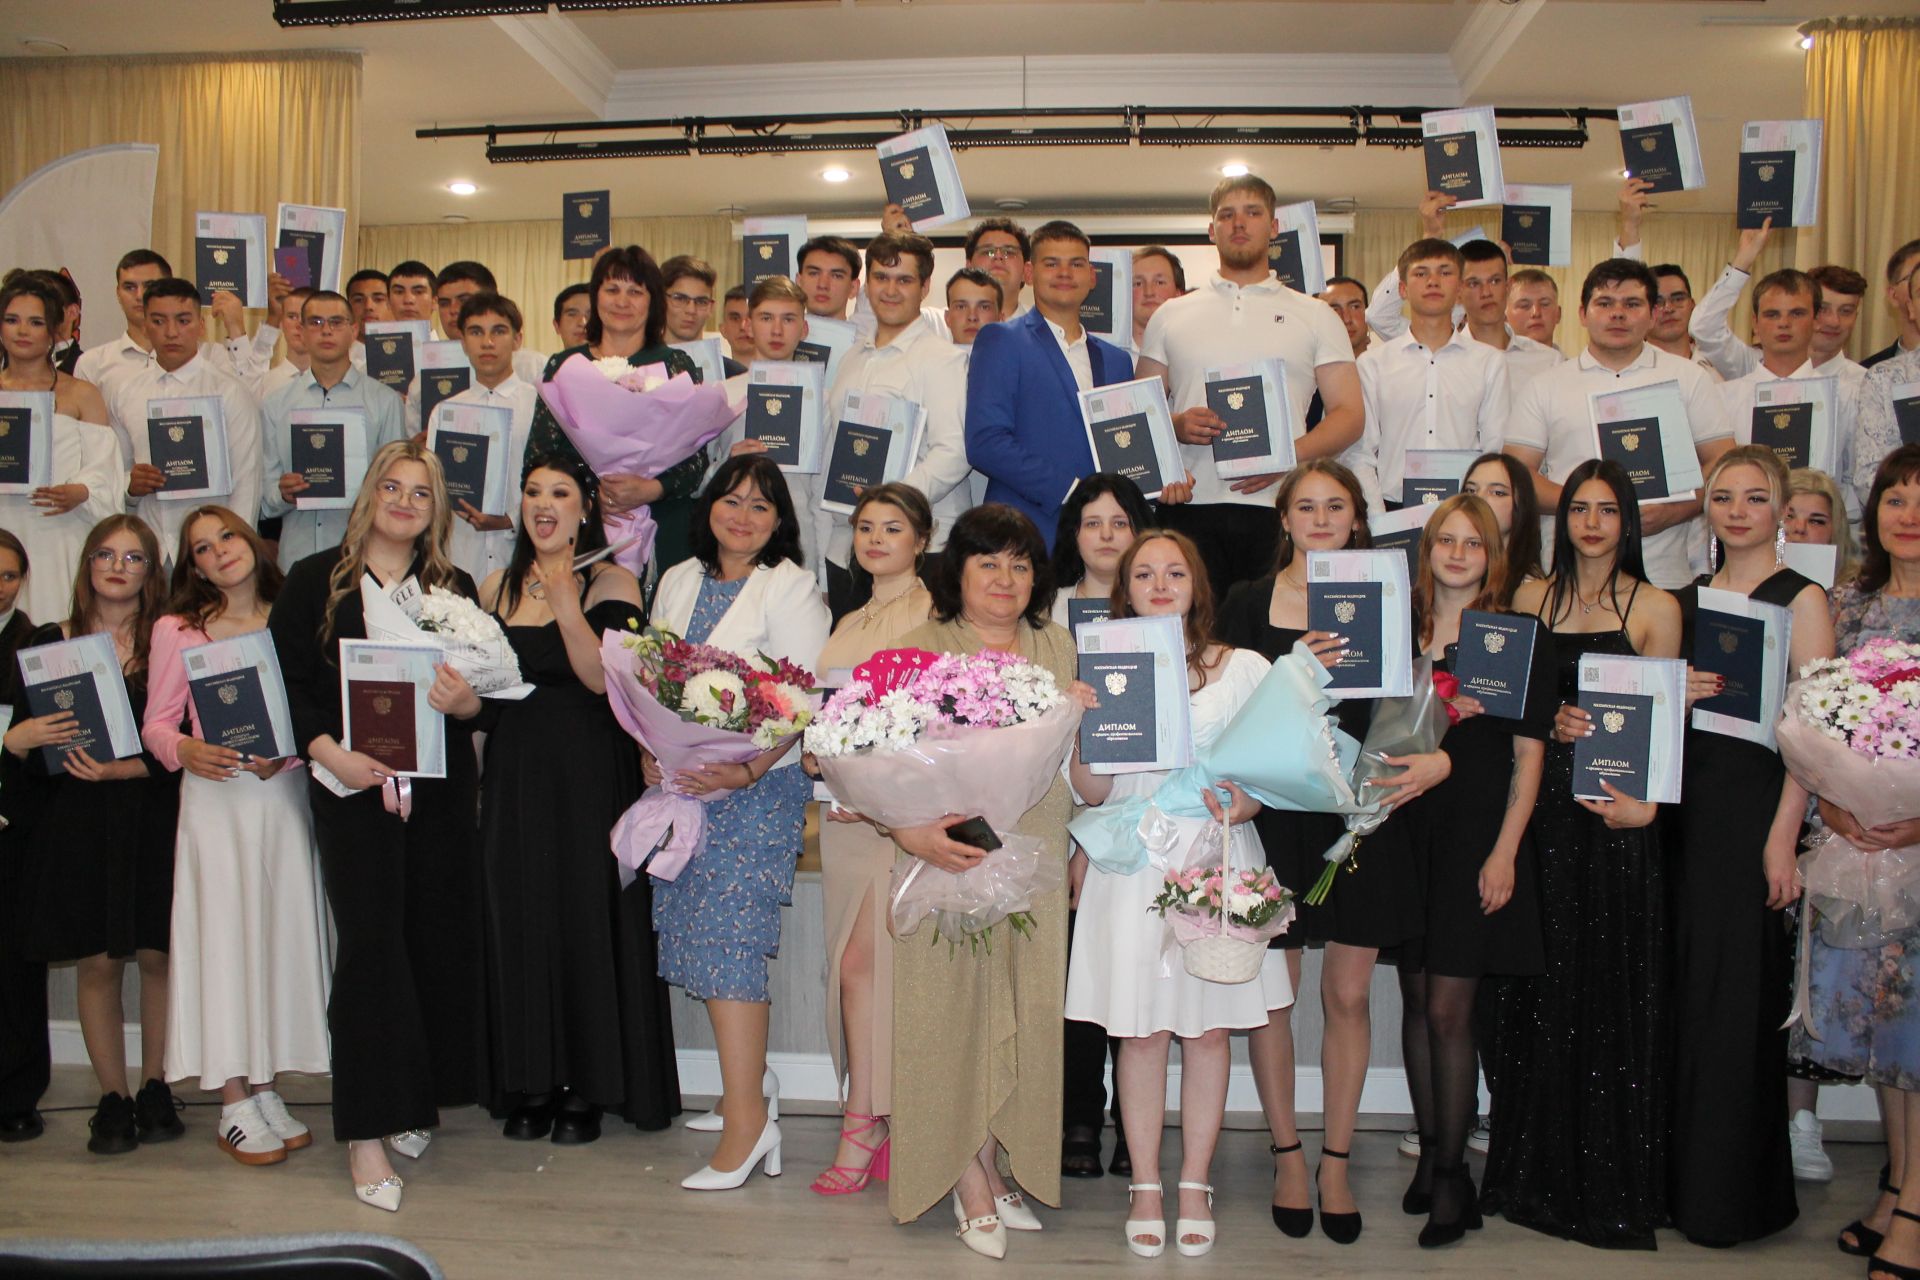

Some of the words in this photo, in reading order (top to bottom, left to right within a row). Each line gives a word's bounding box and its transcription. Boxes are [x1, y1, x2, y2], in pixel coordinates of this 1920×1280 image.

[1441, 172, 1468, 180] ДИПЛОМ
[902, 193, 927, 204] ДИПЛОМ
[1225, 428, 1254, 437] ДИПЛОМ
[1117, 465, 1145, 475] ДИПЛОМ
[841, 474, 868, 483] ДИПЛОМ
[1471, 677, 1507, 688] ДИПЛОМ
[222, 724, 255, 737] ДИПЛОМ
[1098, 723, 1136, 731] ДИПЛОМ
[1592, 758, 1629, 768] ДИПЛОМ
